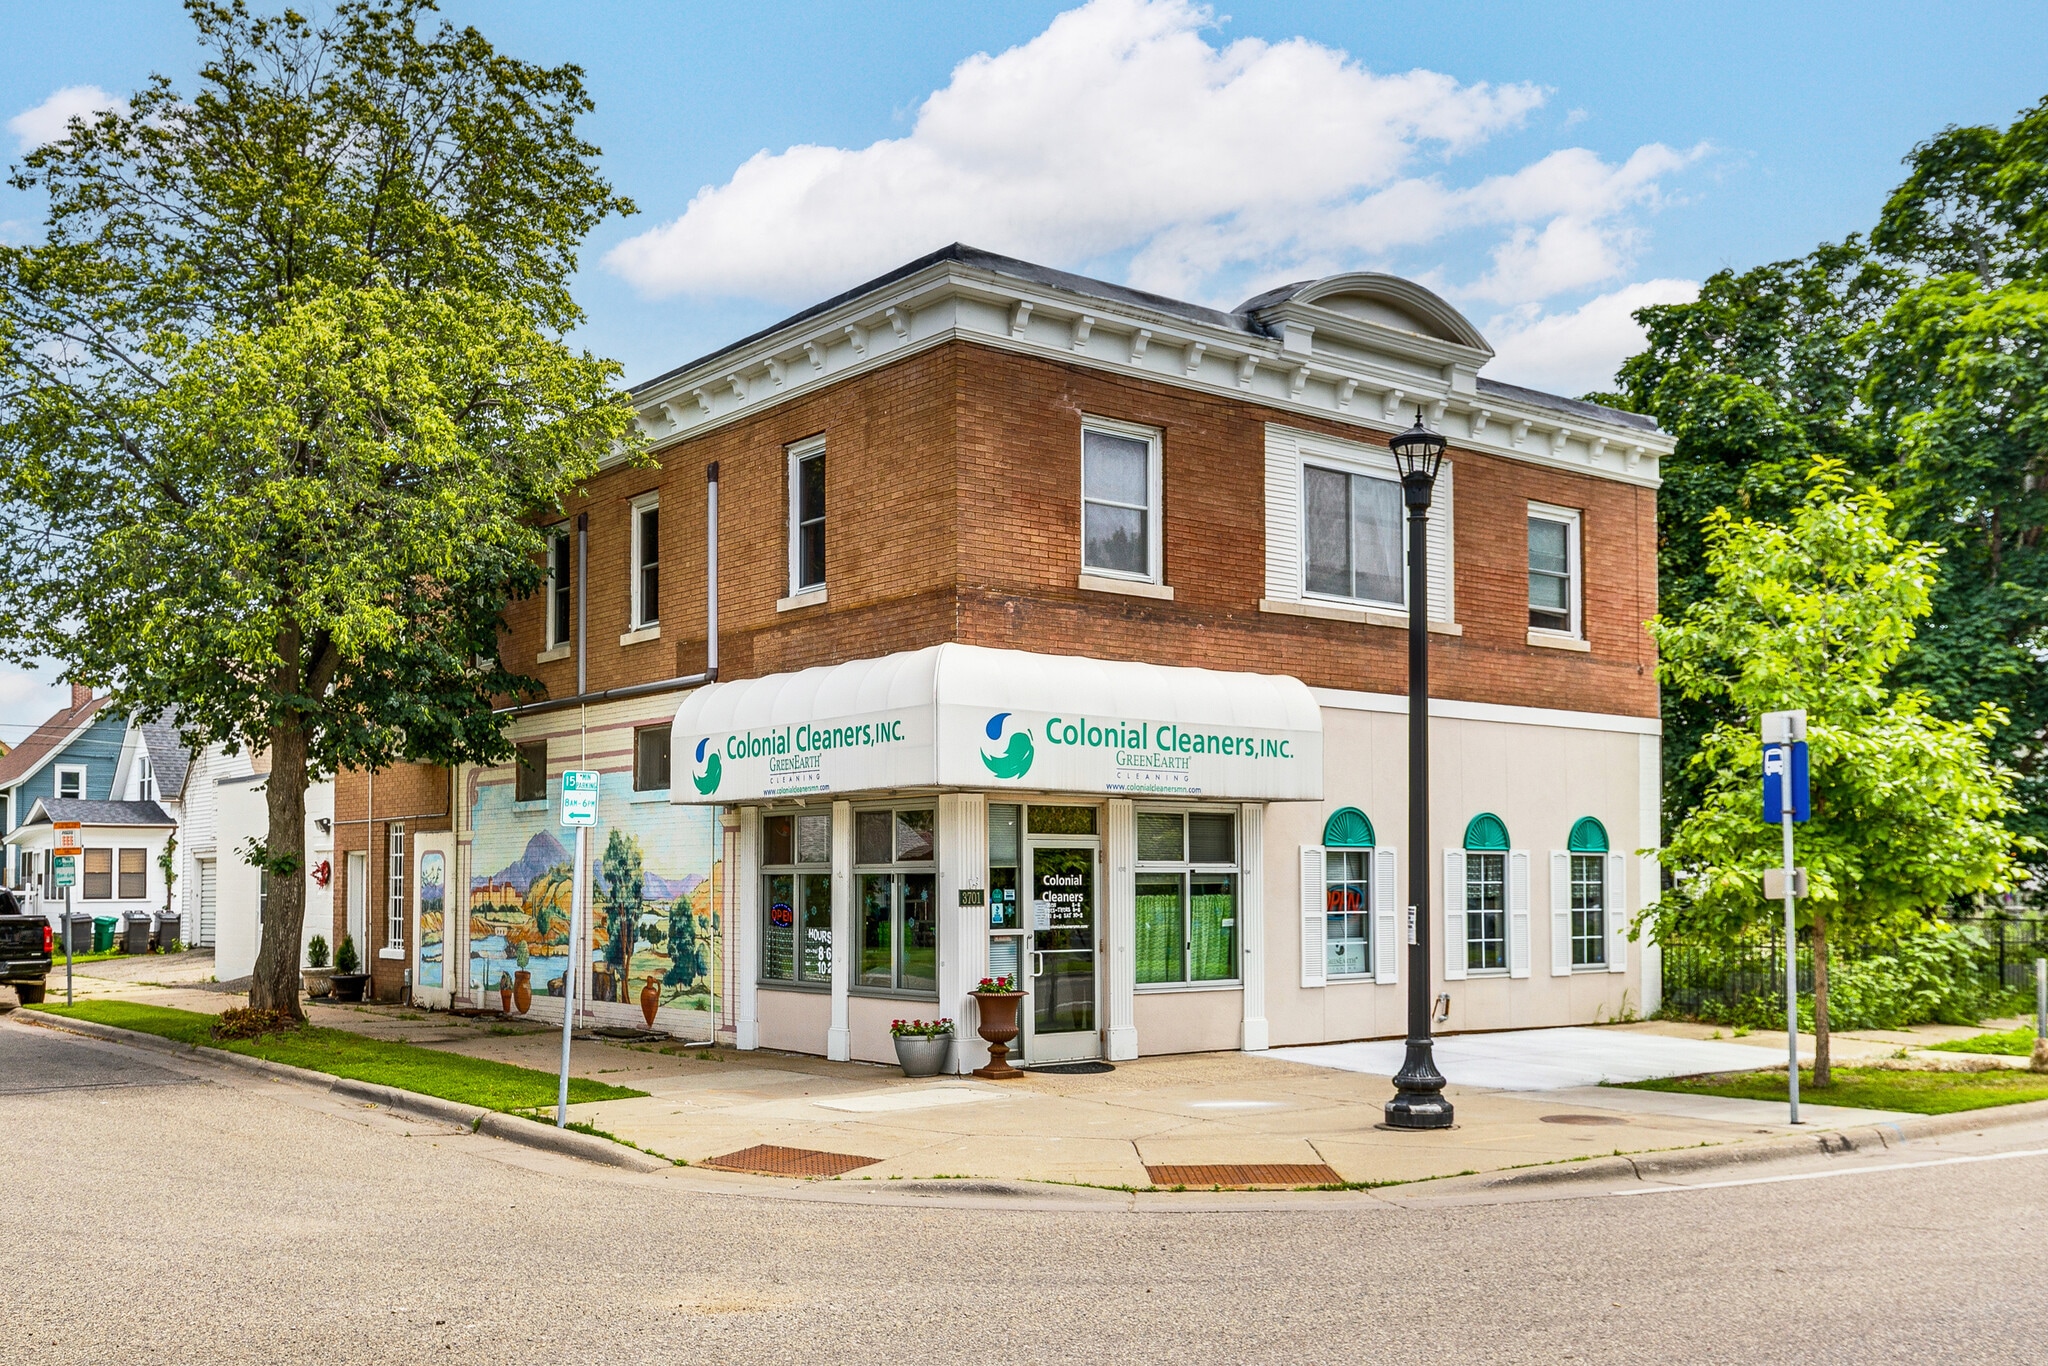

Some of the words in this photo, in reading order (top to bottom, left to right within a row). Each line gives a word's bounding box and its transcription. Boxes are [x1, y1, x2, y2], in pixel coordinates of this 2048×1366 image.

[1046, 717, 1147, 749] Colonial
[726, 726, 790, 760] Colonial
[565, 775, 576, 787] 15
[1043, 874, 1083, 886] Colonial
[962, 891, 981, 904] 3701
[1042, 890, 1084, 902] Cleaners
[772, 910, 792, 922] OPEN
[808, 929, 831, 944] HOURS
